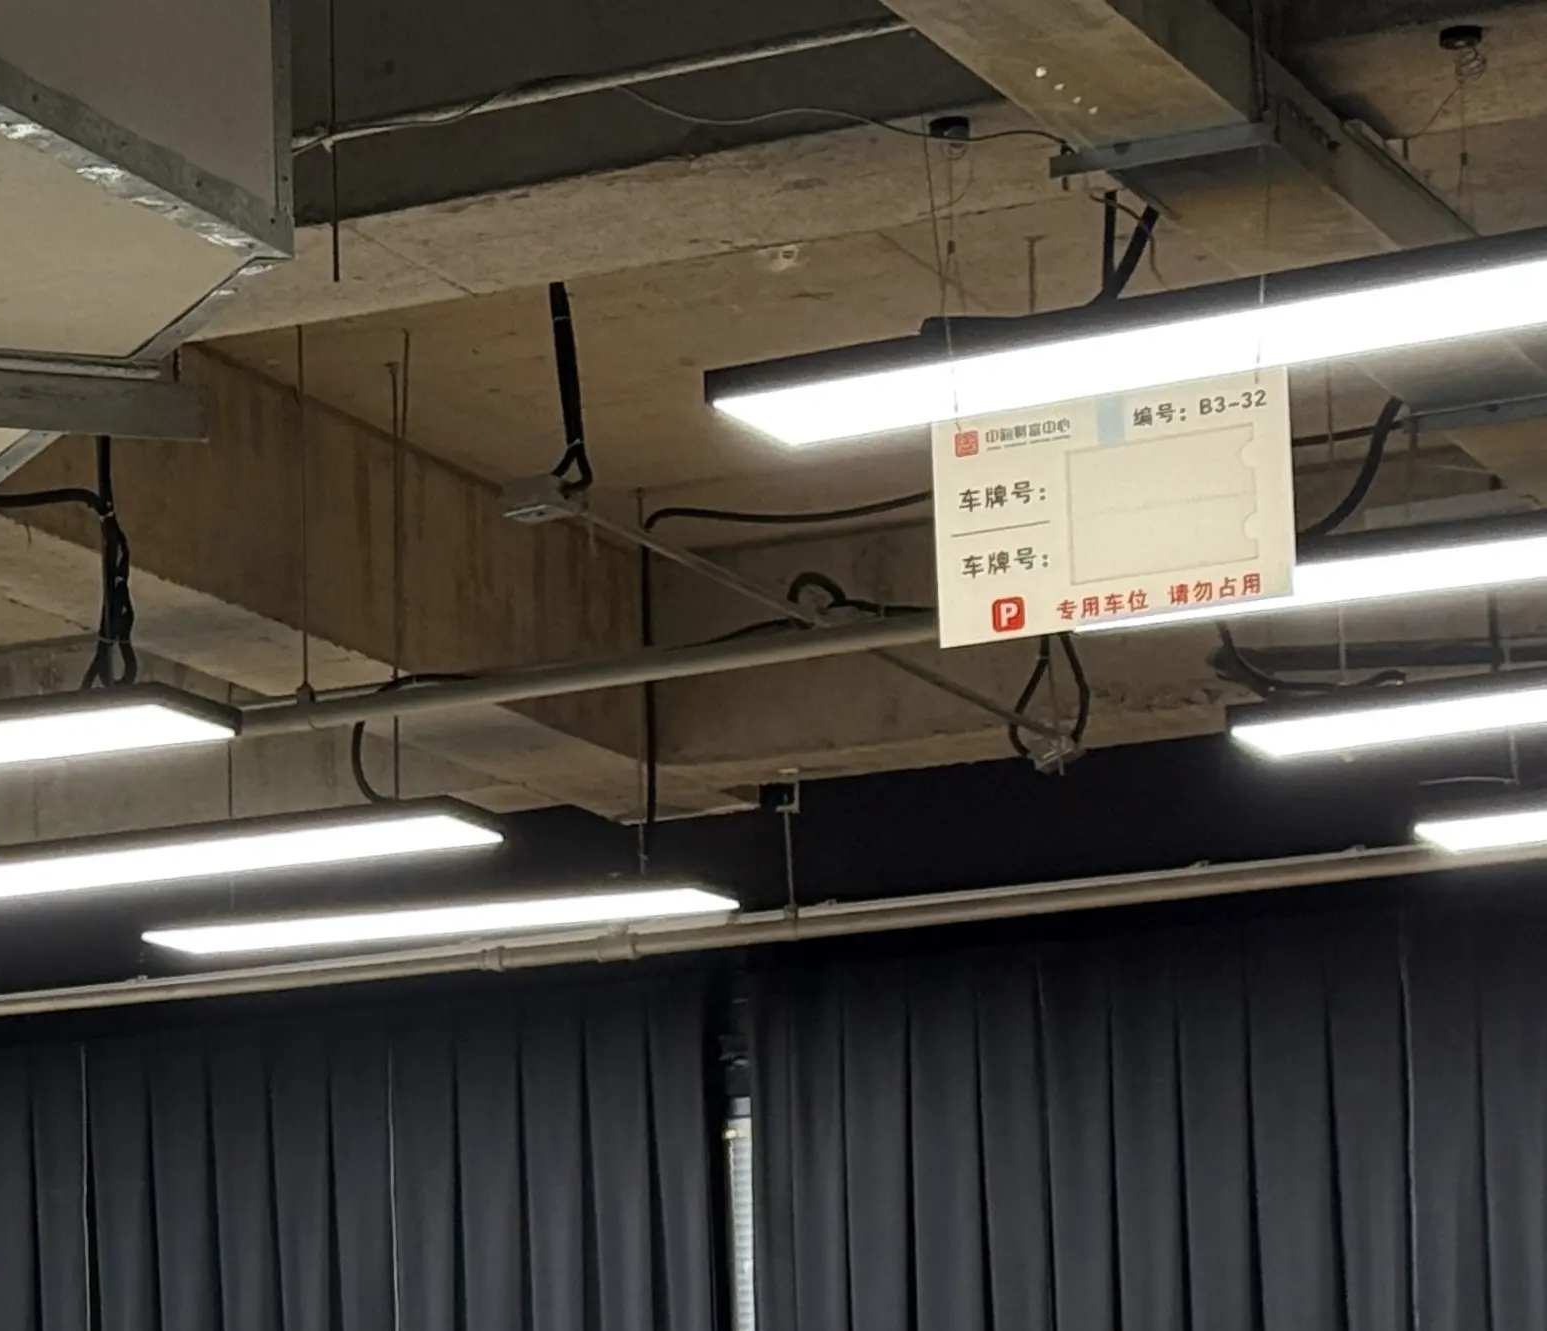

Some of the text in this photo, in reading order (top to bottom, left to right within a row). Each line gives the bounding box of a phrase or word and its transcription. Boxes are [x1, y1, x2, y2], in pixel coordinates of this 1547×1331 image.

[1133, 389, 1267, 426] 编号： B3-32
[959, 480, 1046, 512] 车牌号：
[962, 547, 1049, 579] 车牌号：
[1056, 573, 1262, 620] 专用车位 请勿占用
[1000, 602, 1019, 628] P
